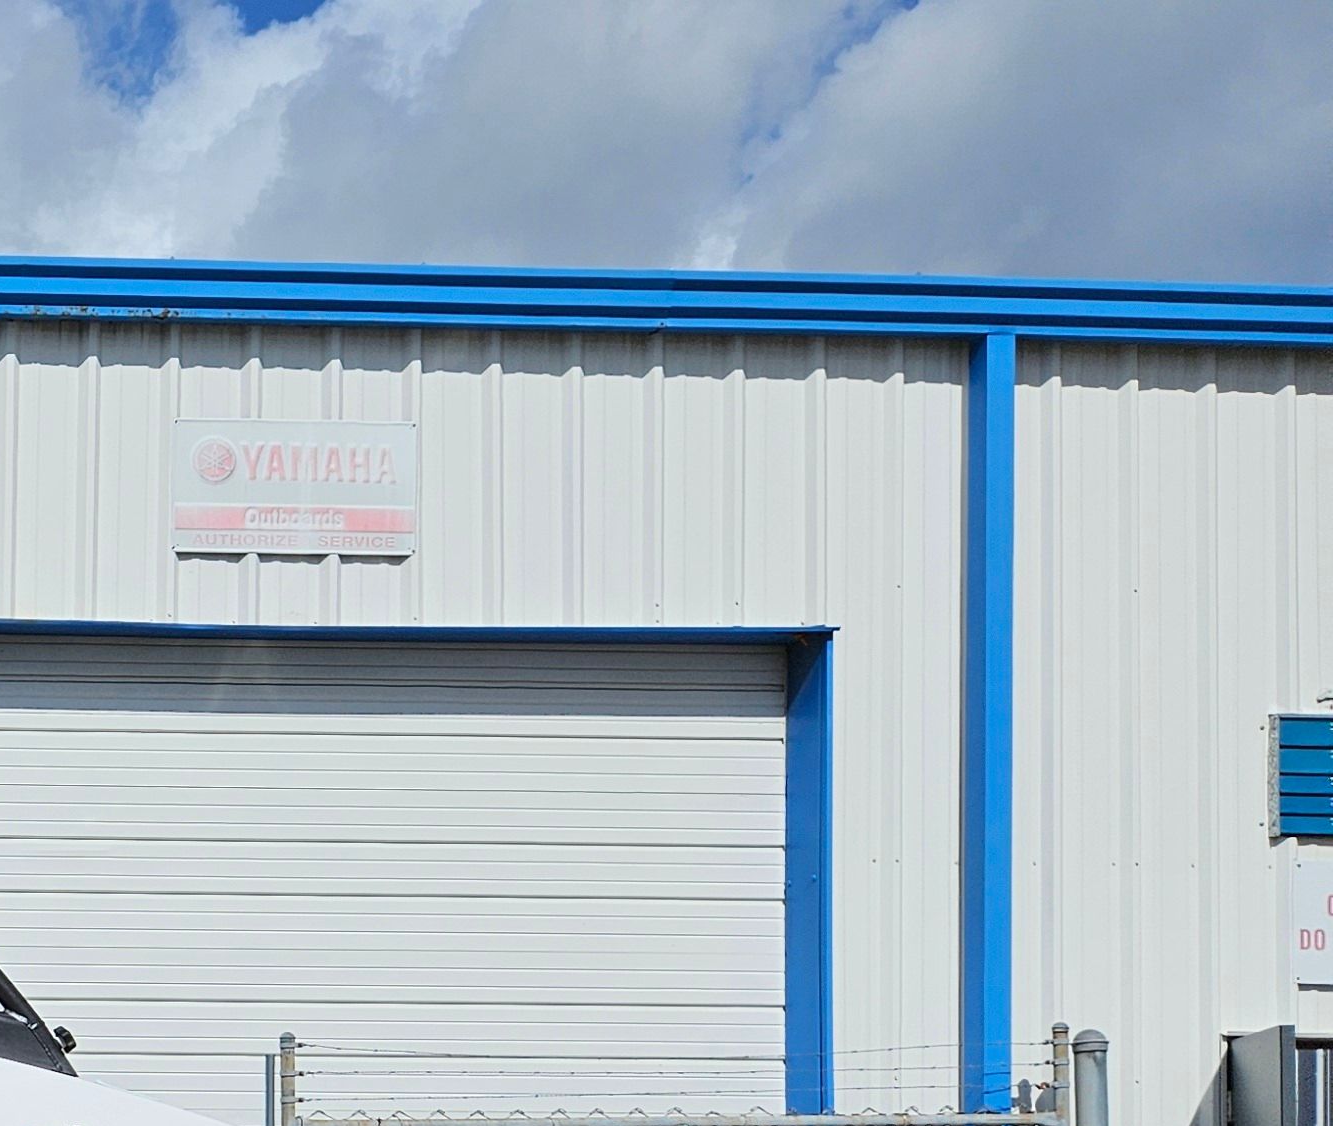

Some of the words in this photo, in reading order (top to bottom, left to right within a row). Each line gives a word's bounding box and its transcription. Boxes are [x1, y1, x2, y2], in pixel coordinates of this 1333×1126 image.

[240, 440, 398, 485] YAMAHA
[318, 535, 396, 548] SERVICE
[1300, 928, 1325, 951] DO
